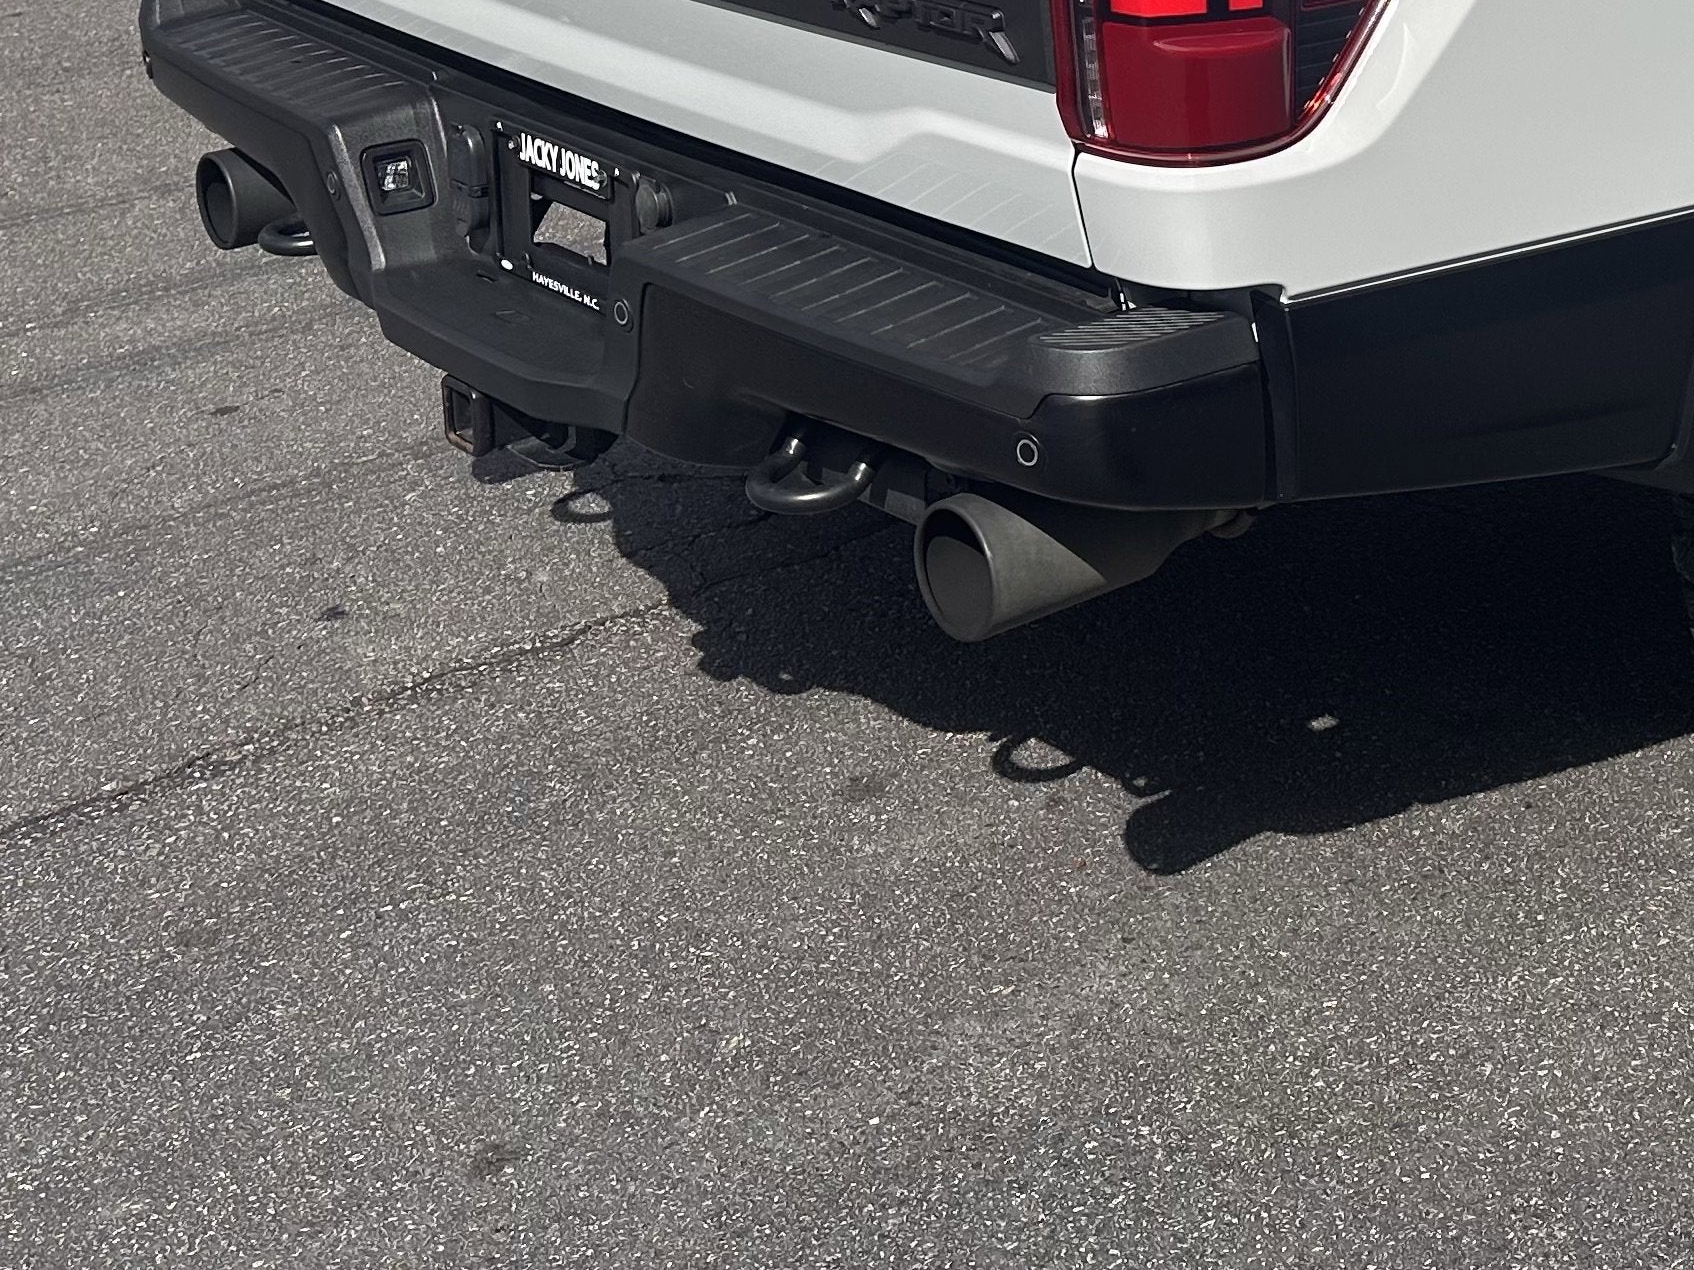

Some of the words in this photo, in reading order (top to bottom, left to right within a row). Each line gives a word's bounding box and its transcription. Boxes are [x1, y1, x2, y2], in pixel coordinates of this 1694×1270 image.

[519, 132, 558, 172] JACKY
[558, 148, 601, 190] JONES
[532, 271, 582, 302] HAYESVILLE,
